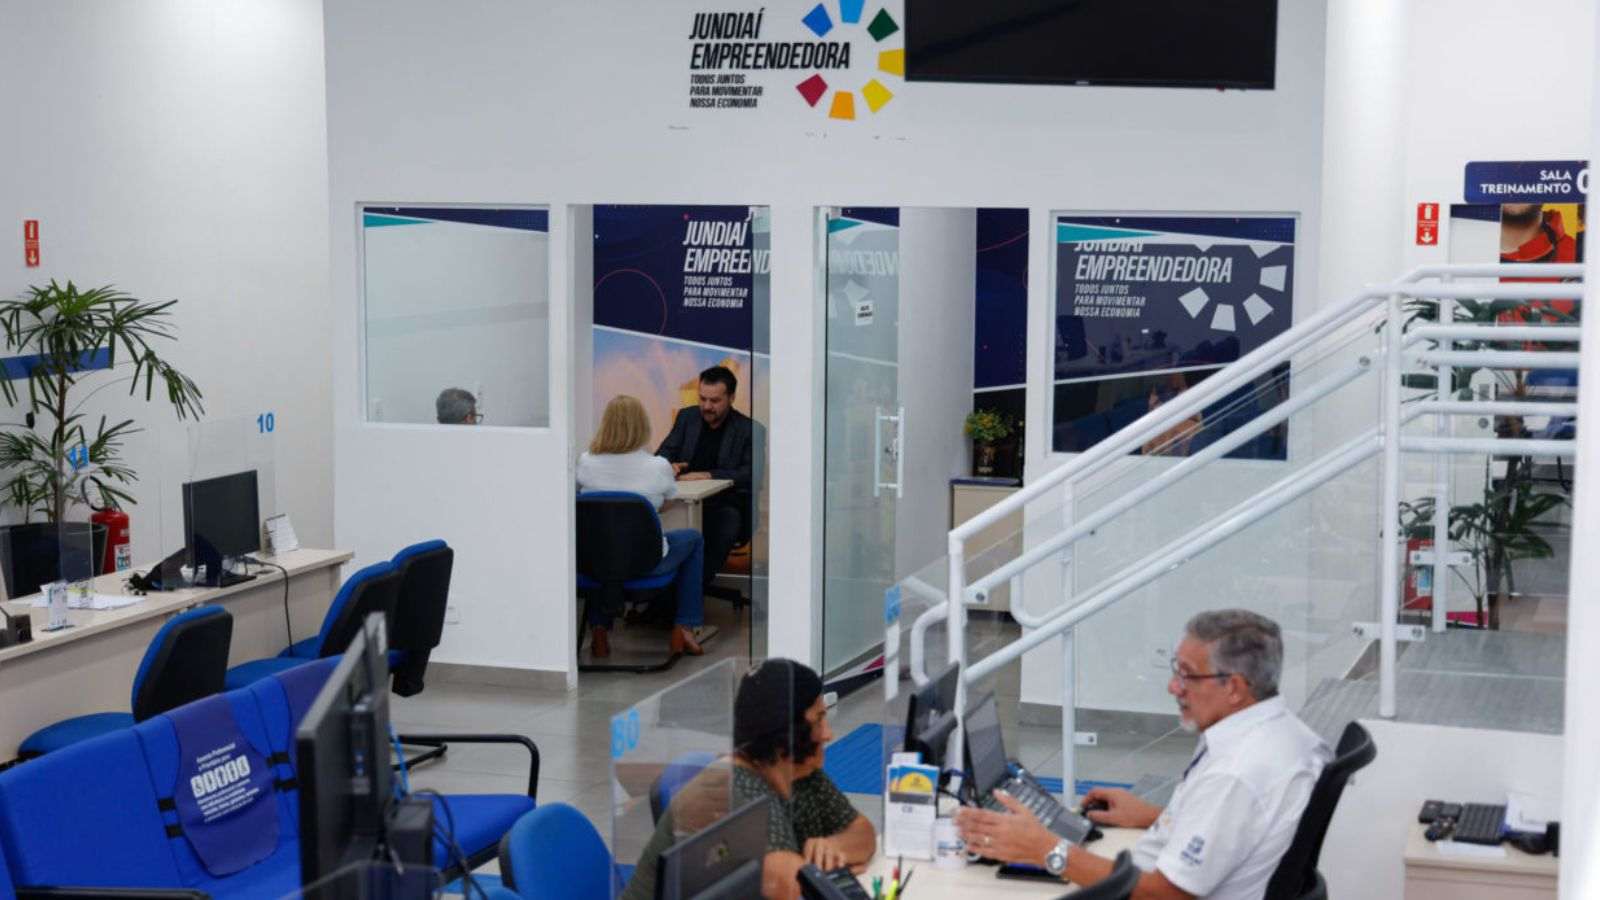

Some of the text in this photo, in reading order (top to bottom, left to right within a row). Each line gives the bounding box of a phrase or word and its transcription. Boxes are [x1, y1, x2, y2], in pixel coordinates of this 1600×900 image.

[689, 7, 765, 40] JUNDIAÍ
[690, 42, 850, 70] EMPREENDEDORA
[690, 74, 745, 84] TODOS JUNTOS
[690, 86, 763, 97] PARA MOVIMENTAR
[690, 98, 758, 108] NOSSA ECONOMIA
[1540, 170, 1572, 181] SALA
[1480, 183, 1571, 194] TREINAMENTO
[683, 216, 751, 246] JUNDIAÍ
[1075, 254, 1232, 283] EMPREENDEDORA
[684, 275, 732, 286] TODOS JUNTOS
[684, 287, 748, 298] PARA MOVIMENTAR
[1075, 284, 1129, 295] TODOS JUNTOS
[684, 297, 743, 308] NOSSA ECONOMIA
[1074, 295, 1146, 307] PARA MOVIMENTAR
[1074, 306, 1140, 318] NOSSA ECONOMIA
[257, 412, 275, 433] 10
